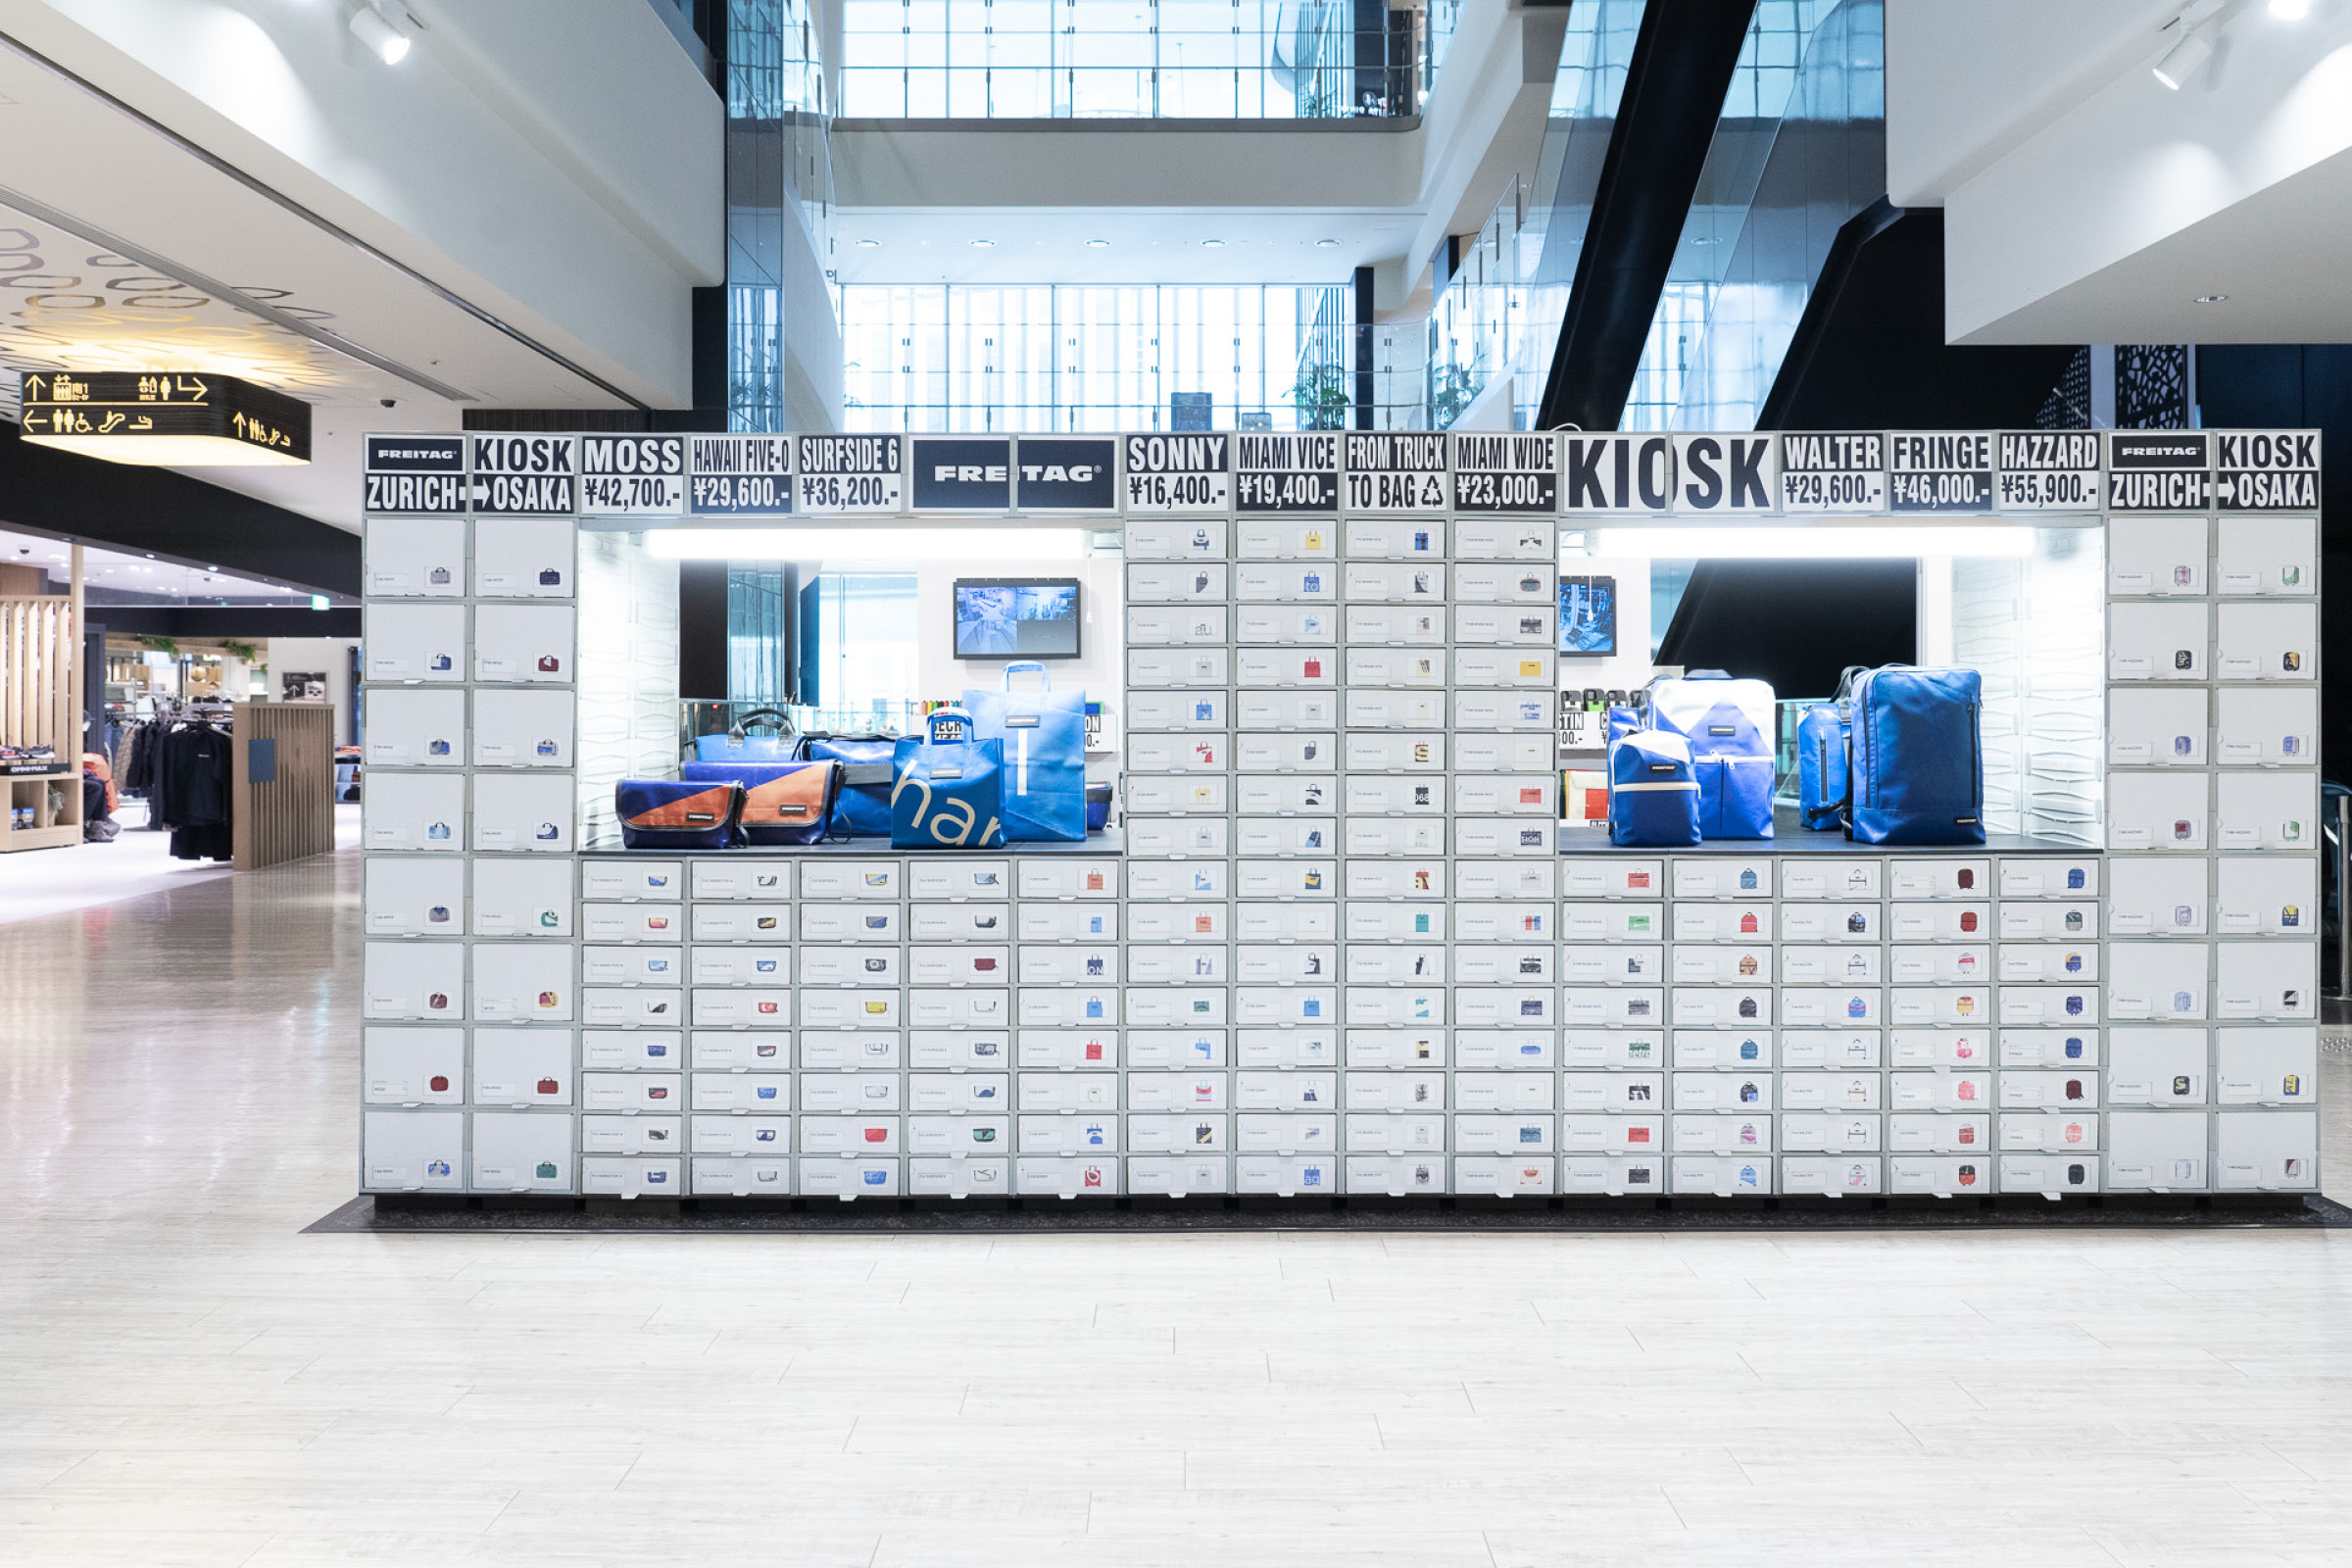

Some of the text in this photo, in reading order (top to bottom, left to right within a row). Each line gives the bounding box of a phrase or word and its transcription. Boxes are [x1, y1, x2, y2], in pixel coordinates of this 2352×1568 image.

[377, 449, 454, 460] FREITAG
[474, 438, 572, 472] KIOSK
[584, 439, 681, 473] MOSS
[694, 440, 742, 472] HAWAII
[802, 438, 898, 472] SURFSIDE 6
[1129, 437, 1225, 472] SONNY
[1239, 437, 1335, 470] MIAMI VICE
[1348, 436, 1445, 470] FROM TRUCK
[1458, 437, 1554, 470] MIAMI WIDE
[1785, 436, 1882, 470] WALTER
[1894, 436, 1989, 469] FRINGE
[2001, 435, 2097, 469] HAZZARD
[2122, 447, 2198, 457] FREITAG
[2219, 435, 2316, 468] KIOSK
[934, 465, 1102, 482] FRETAG®
[1568, 437, 1771, 510] KIOSK
[2111, 473, 2317, 508] ZURICH OSAKA
[367, 477, 571, 512] ZURICH OSAKA
[584, 478, 681, 512] ¥42,700.-
[694, 477, 789, 512] ¥29,600.-
[803, 477, 899, 511] ¥36,200.-
[1130, 475, 1225, 510] ¥16,400.-
[1240, 474, 1335, 509] ¥19,400.-
[1348, 474, 1415, 508] TO BAG
[1457, 474, 1554, 509] ¥23,000.-
[1786, 475, 1882, 509] ¥29,600.-
[1893, 473, 1989, 509] ¥46,000.-
[2001, 474, 2096, 508] ¥55,900.-
